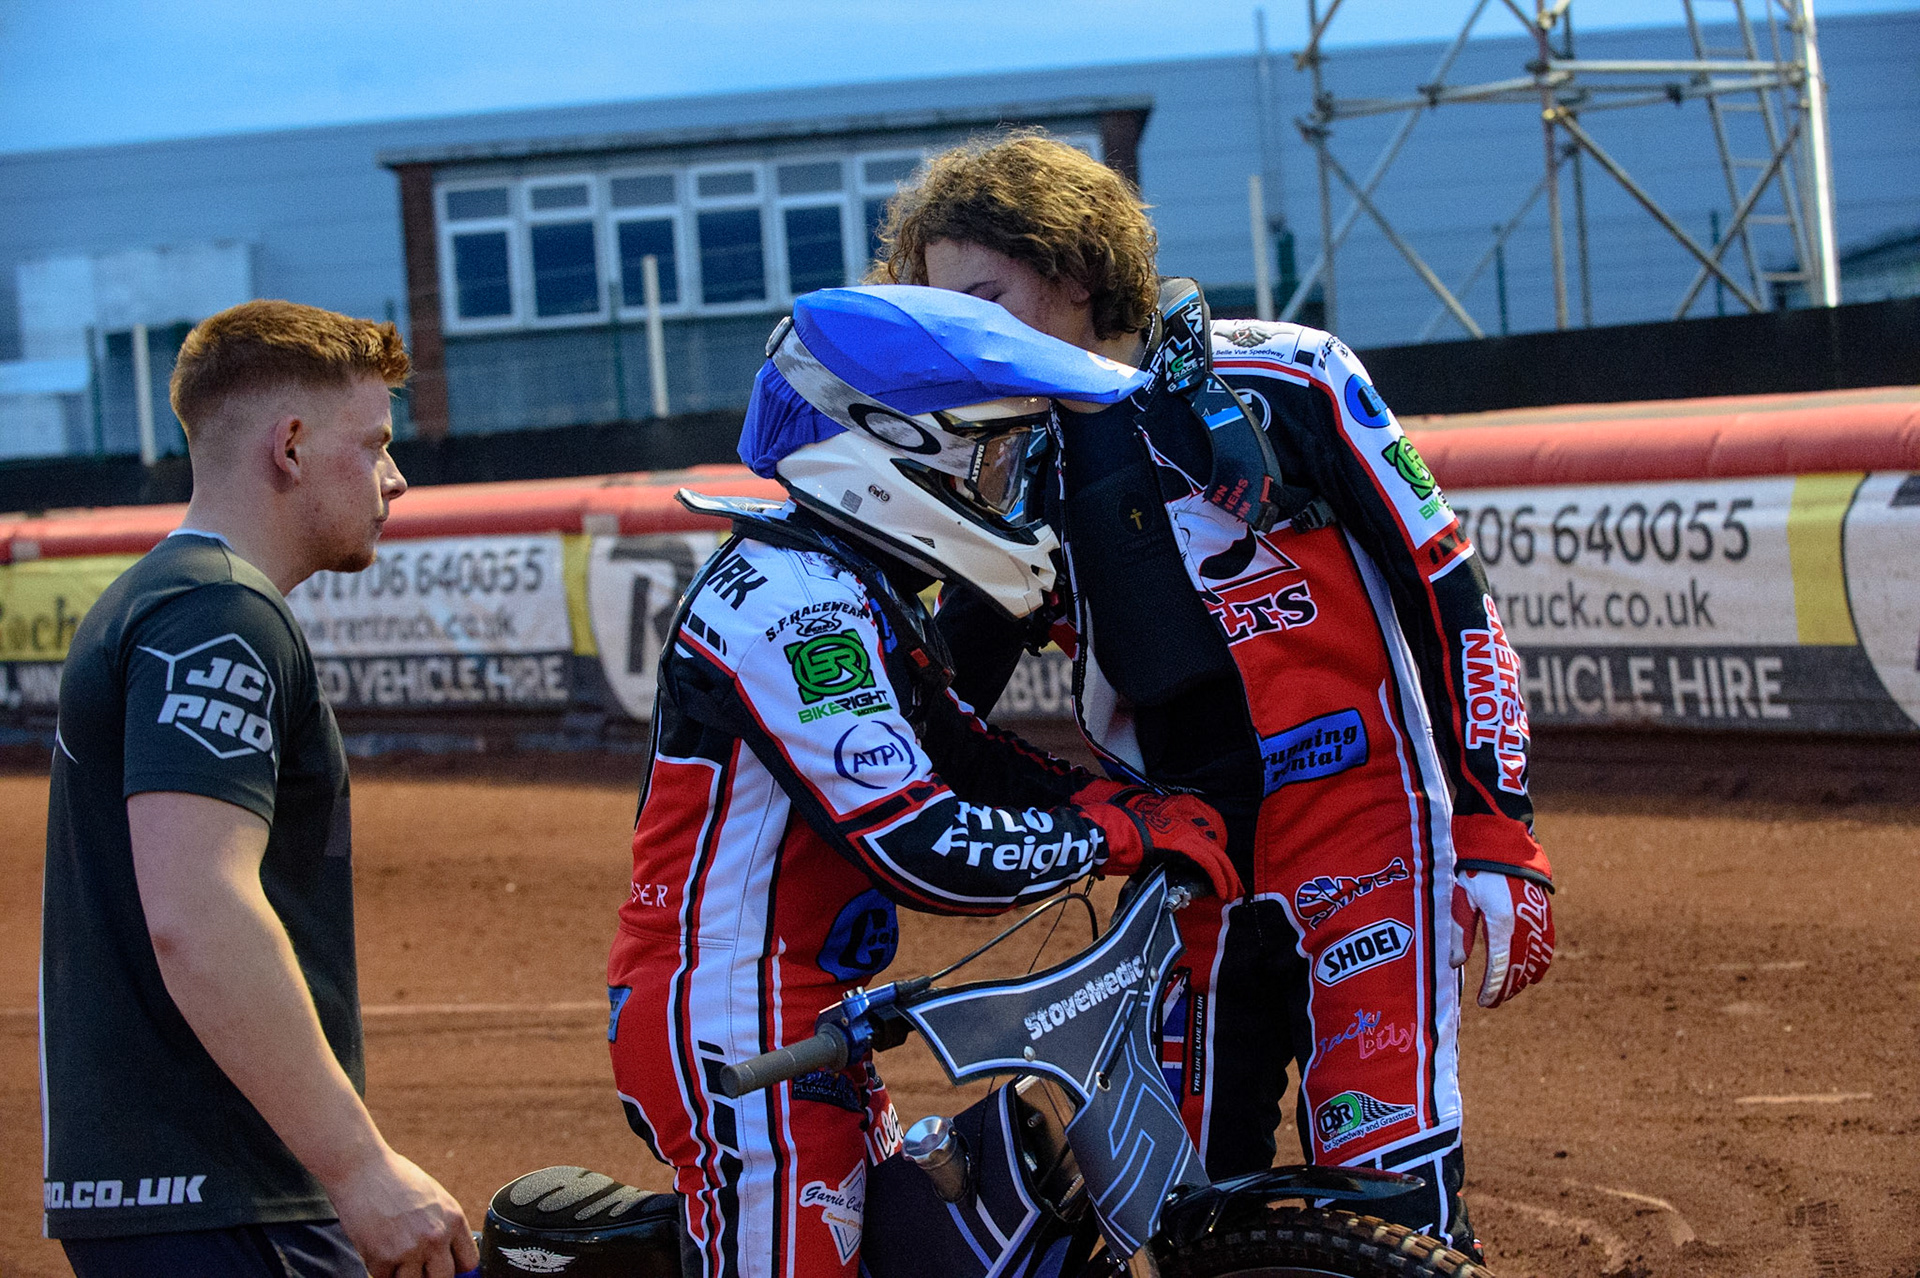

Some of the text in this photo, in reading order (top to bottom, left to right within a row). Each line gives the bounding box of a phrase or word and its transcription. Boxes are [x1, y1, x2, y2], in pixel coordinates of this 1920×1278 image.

[1249, 348, 1285, 359] Speedway
[970, 444, 986, 483] OAKLEY
[1552, 499, 1753, 565] 640055
[414, 545, 545, 598] 640055
[186, 657, 266, 702] JC
[350, 655, 484, 704] VEHICLE
[1464, 632, 1497, 745] TOWN
[1485, 596, 1525, 792] KITCHENS
[1667, 655, 1792, 719] HIRE
[157, 693, 273, 753] PRO
[853, 742, 904, 774] ATPI
[931, 825, 1104, 880] Freight
[1323, 926, 1402, 979] SHOEI
[1312, 1008, 1381, 1070] Jack
[1357, 1022, 1416, 1060] Lily
[1331, 1127, 1365, 1148] Speedway
[1365, 1120, 1380, 1133] and
[1379, 1108, 1416, 1127] Grasstrack
